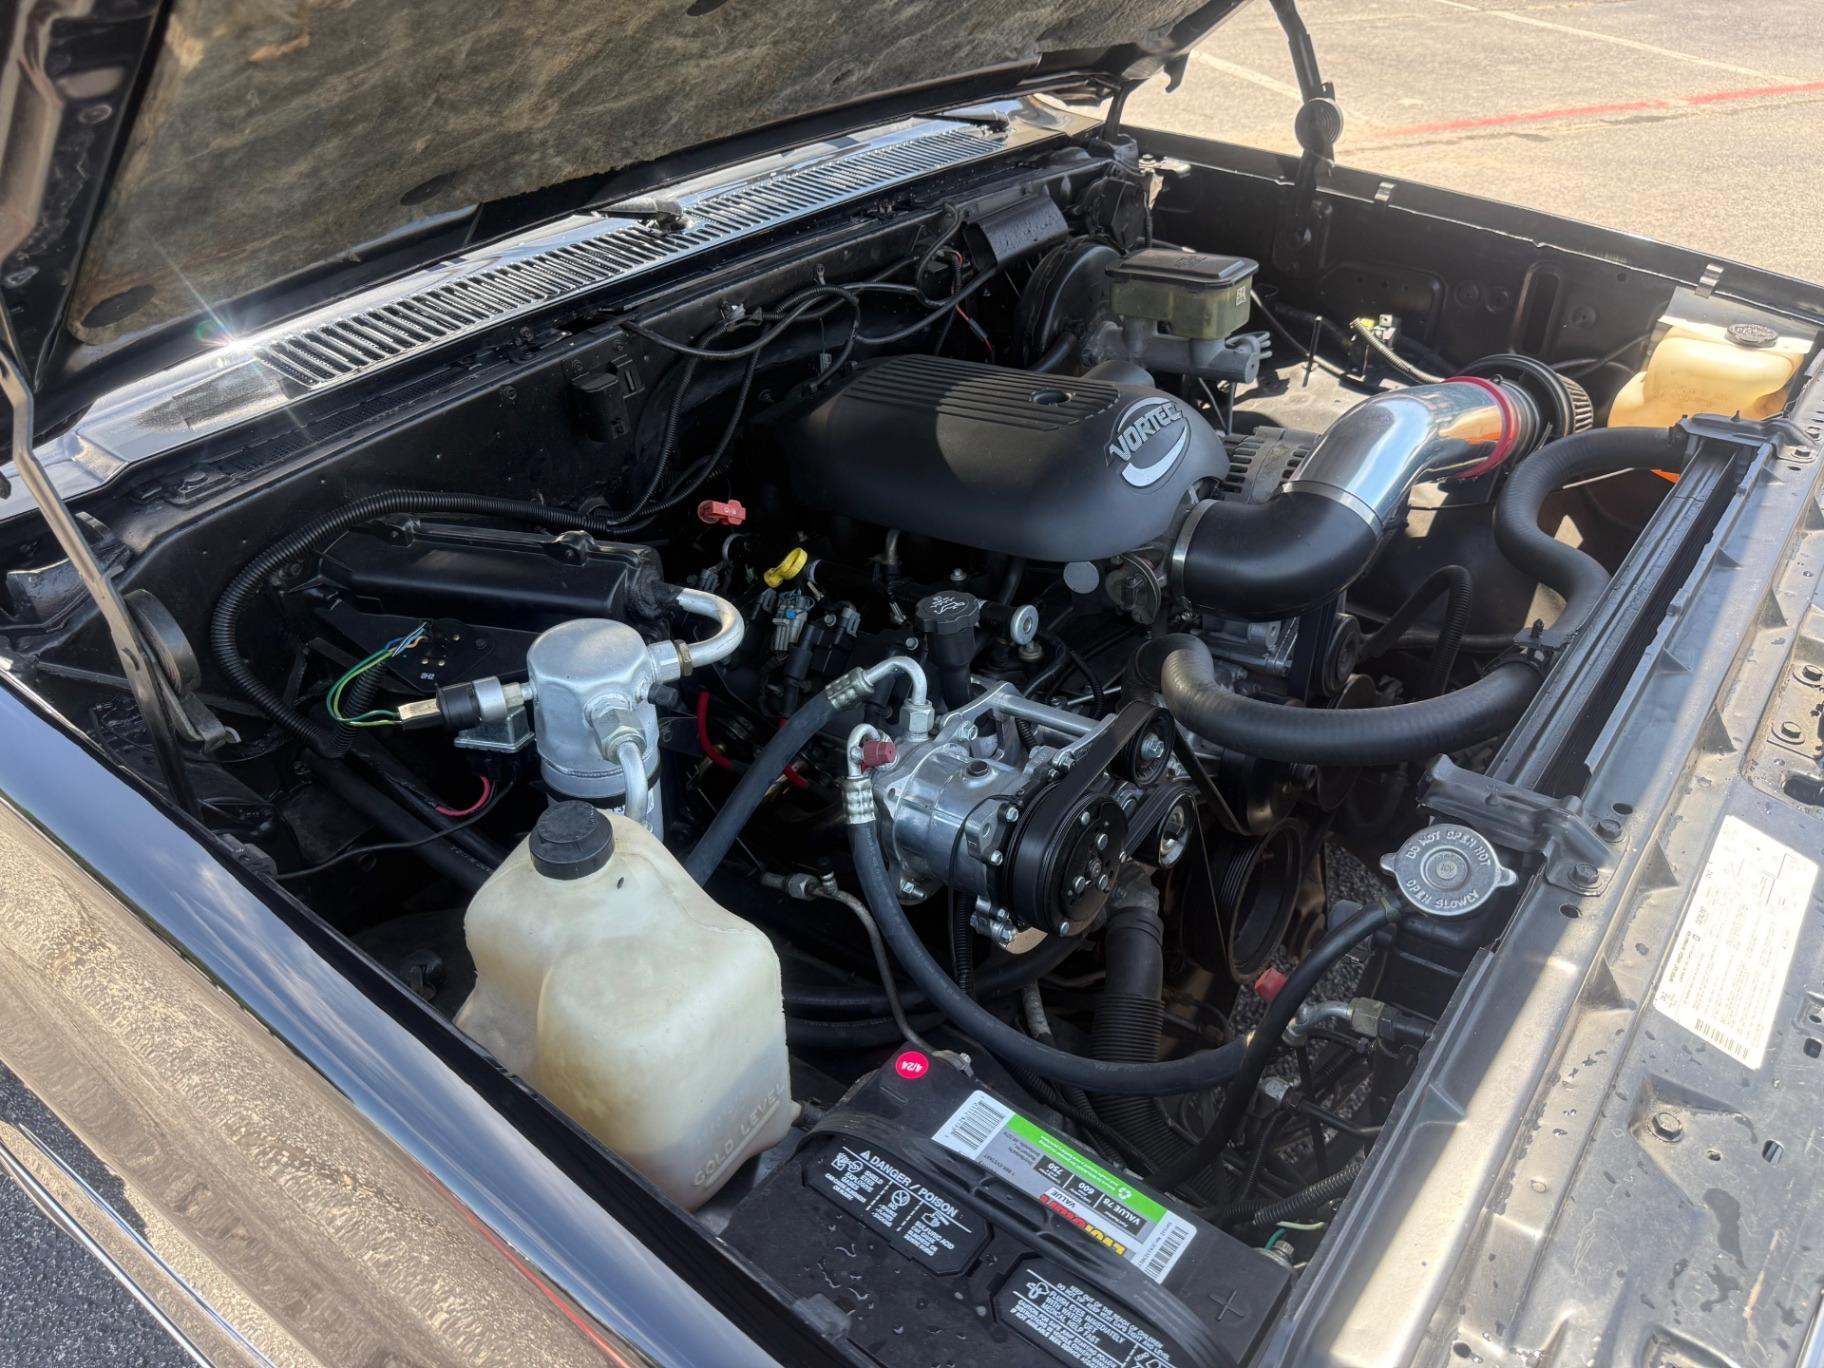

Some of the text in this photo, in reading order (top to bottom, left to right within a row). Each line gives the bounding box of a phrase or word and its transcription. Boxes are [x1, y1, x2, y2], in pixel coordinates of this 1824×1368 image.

[1109, 402, 1182, 460] VORTEC
[1406, 830, 1491, 866] DO NOT OPEN HOT
[1406, 880, 1431, 904] OPEN
[902, 1061, 922, 1072] 4/24
[694, 1083, 785, 1185] COLD LEVEL
[870, 1156, 911, 1186] DANGER
[917, 1188, 958, 1217] POISON
[1048, 1163, 1063, 1175] 750
[1051, 1191, 1076, 1208] VALUE
[1079, 1183, 1095, 1194] 600
[1103, 1199, 1140, 1225] VALUE 78
[1041, 1303, 1100, 1344] MEDICAL HELP FAST
[1046, 1297, 1061, 1310] WITH
[1084, 1323, 1098, 1333] GET
[1049, 1291, 1125, 1343] FLUSH EYES IMMEDIATELY
